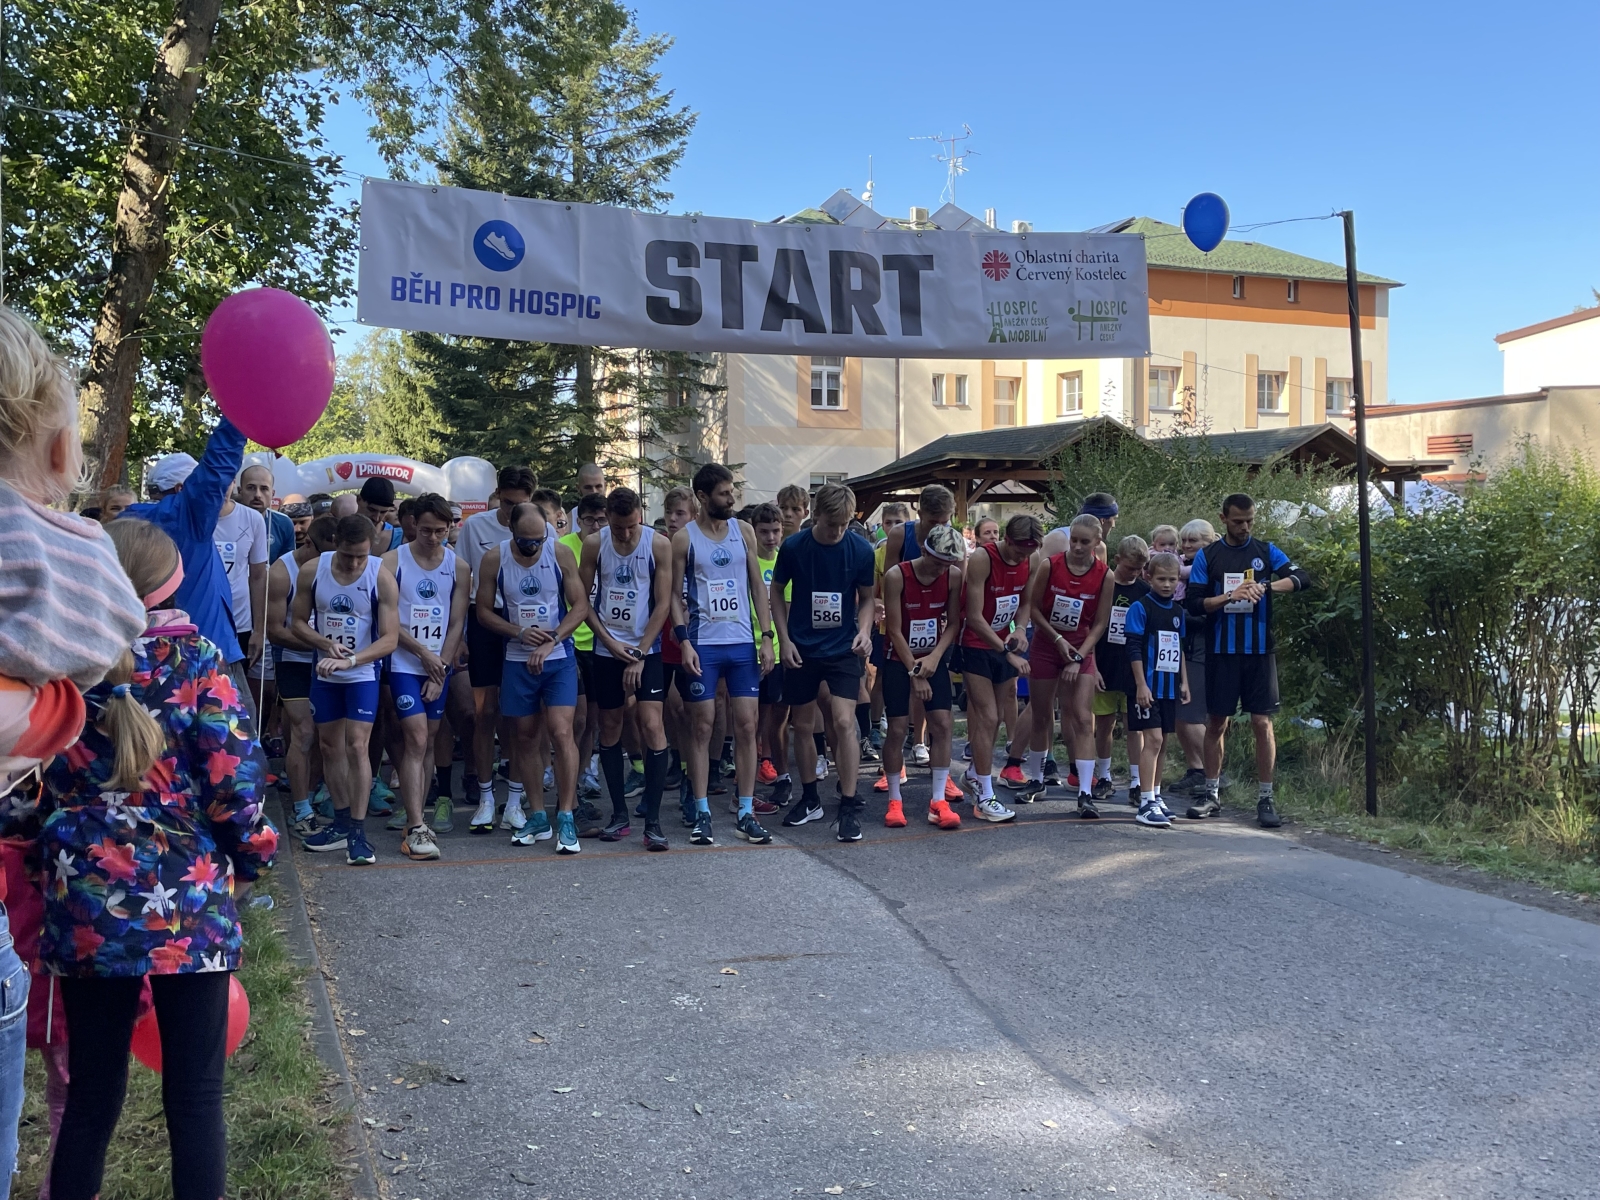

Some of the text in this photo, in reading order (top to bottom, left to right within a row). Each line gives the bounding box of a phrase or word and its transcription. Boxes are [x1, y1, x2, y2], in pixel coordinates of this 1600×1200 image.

[1015, 249, 1119, 264] Oblastní charita
[1016, 264, 1127, 284] Červený Kostelec
[391, 271, 601, 320] BĚH PRO HOSPIC
[645, 239, 935, 337] START
[359, 463, 410, 480] PRIMATOR
[711, 597, 738, 612] 106
[611, 607, 631, 621] 96
[813, 610, 841, 622] 586
[992, 611, 1015, 625] 501
[1051, 611, 1079, 627] 545
[326, 620, 343, 628] CUP
[411, 624, 442, 640] 114
[910, 636, 936, 649] 502
[1159, 648, 1179, 662] 612
